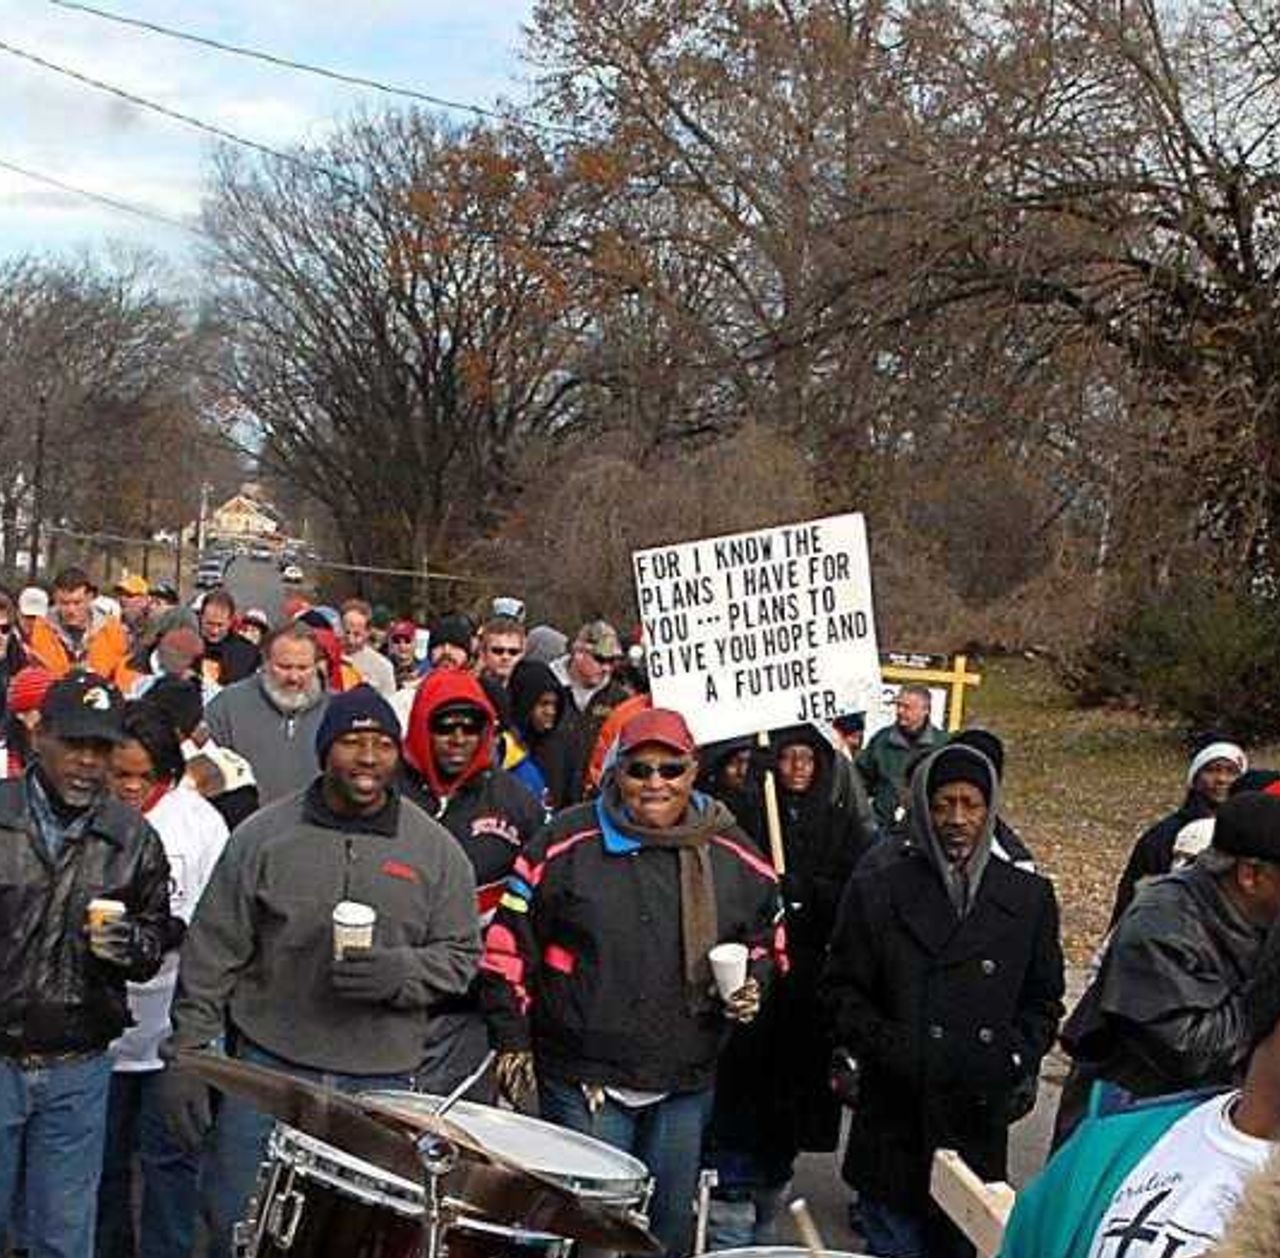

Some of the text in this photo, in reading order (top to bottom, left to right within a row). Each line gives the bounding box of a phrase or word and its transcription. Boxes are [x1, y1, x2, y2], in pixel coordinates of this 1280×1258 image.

[636, 526, 822, 585] FOR I KNOW THE
[641, 552, 850, 615] PLANS I HAVE FOR
[645, 613, 688, 646] YOU
[728, 594, 799, 631] PLANS
[808, 586, 836, 616] TO
[649, 611, 868, 678] GIVE YOU HOPE AND
[706, 657, 820, 702] A FUTURE
